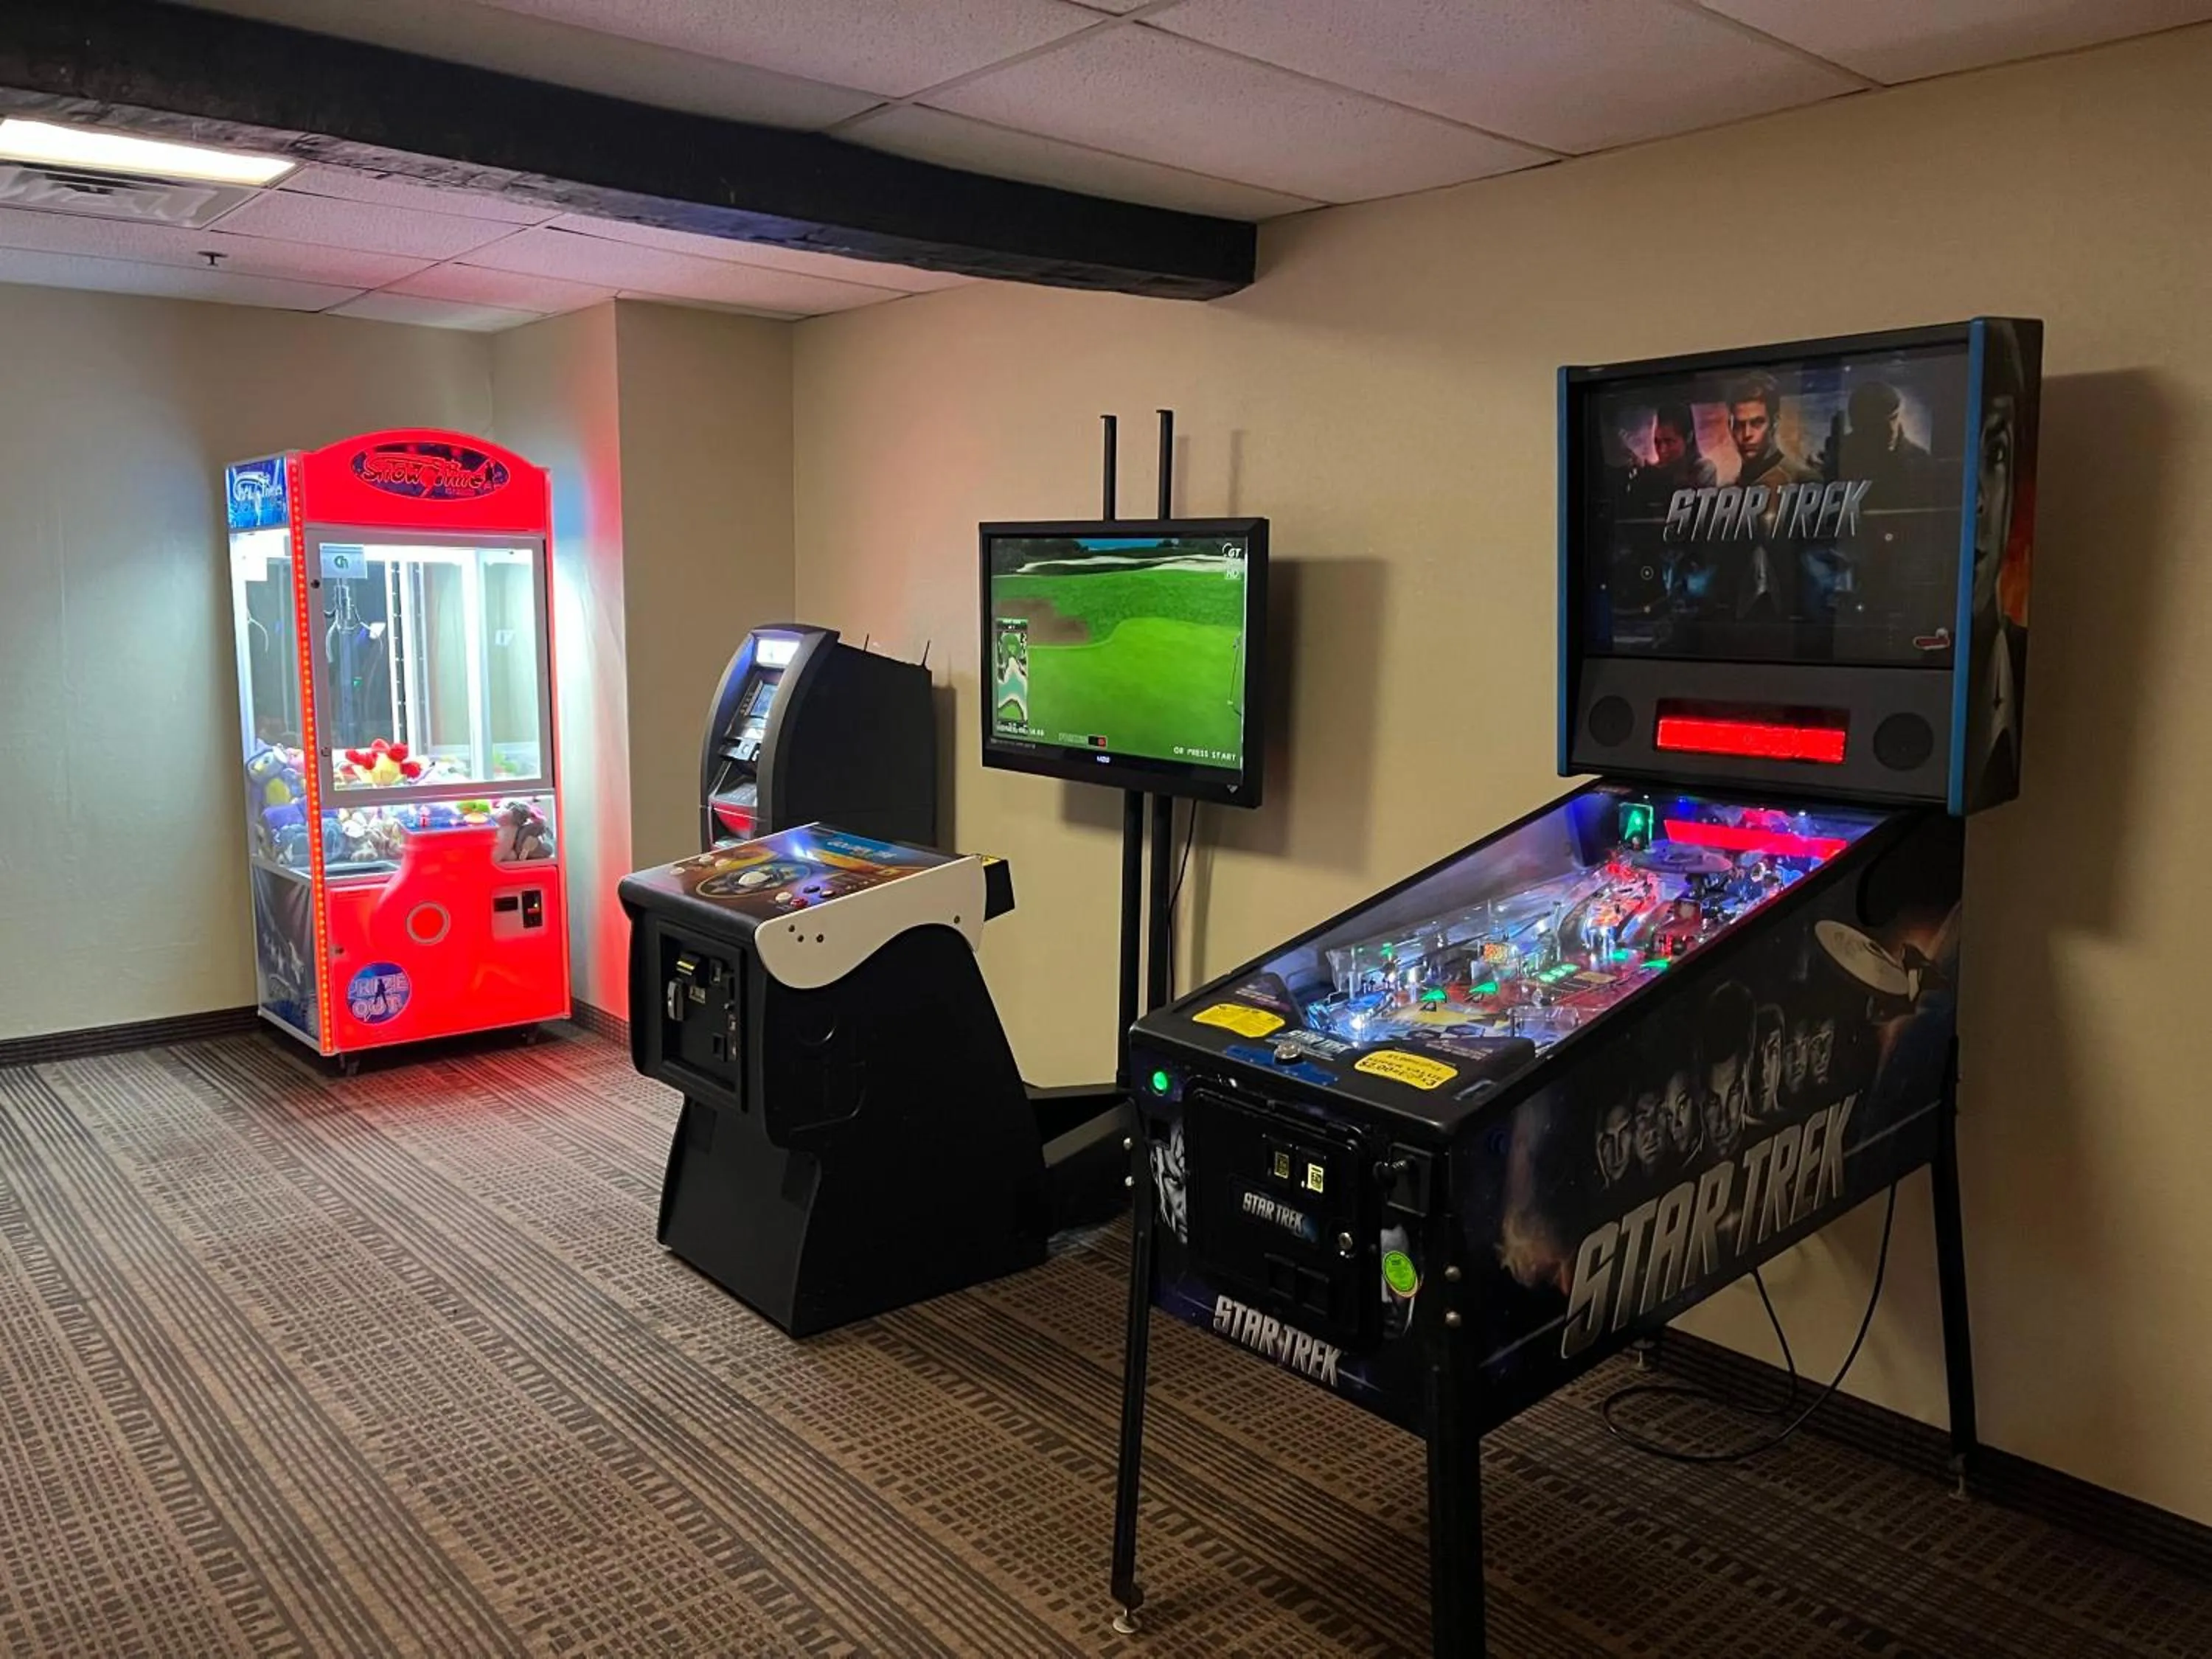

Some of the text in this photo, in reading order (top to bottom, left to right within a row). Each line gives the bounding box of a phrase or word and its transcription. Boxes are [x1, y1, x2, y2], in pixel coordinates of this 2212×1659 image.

[1663, 480, 1873, 541] STAR TREK
[1186, 748, 1209, 758] PRESS
[1211, 751, 1237, 762] START
[1242, 1192, 1304, 1234] STAR TREK
[1560, 1091, 1858, 1359] STAR TREK
[1213, 1294, 1342, 1388] STAR TREK
